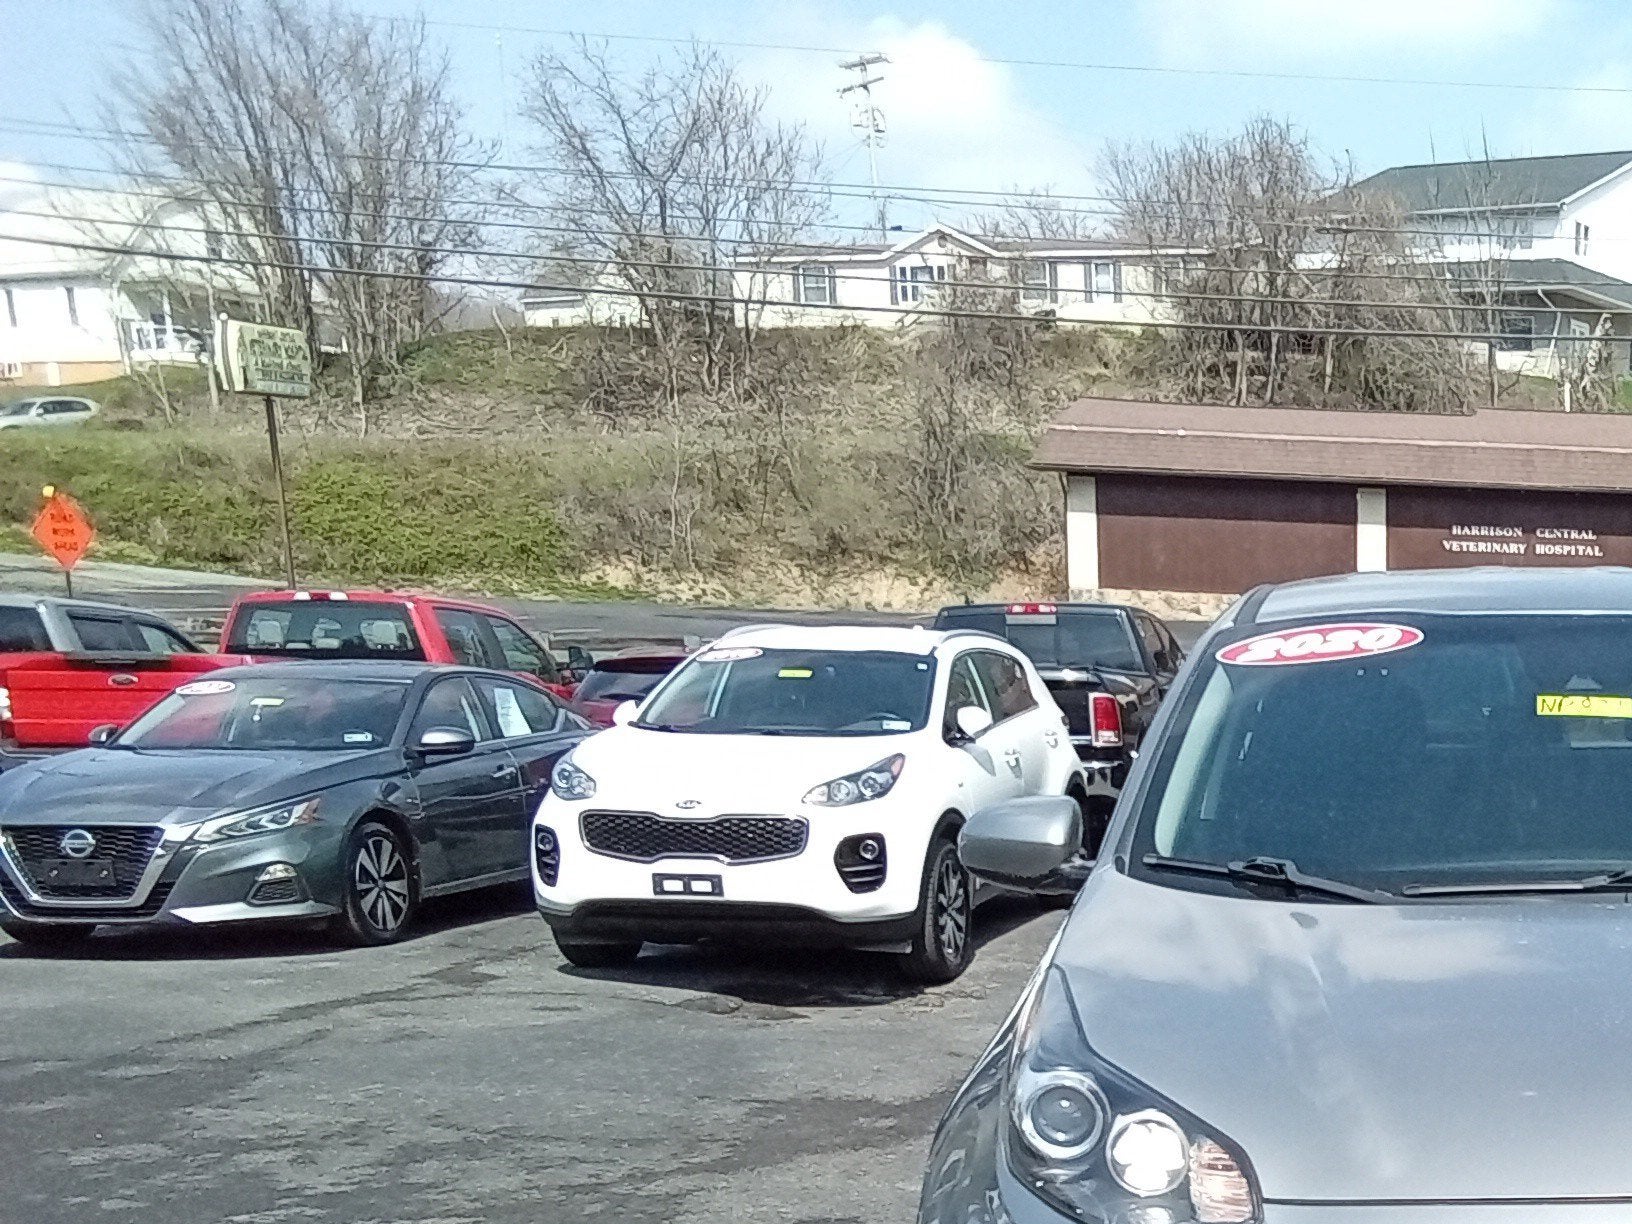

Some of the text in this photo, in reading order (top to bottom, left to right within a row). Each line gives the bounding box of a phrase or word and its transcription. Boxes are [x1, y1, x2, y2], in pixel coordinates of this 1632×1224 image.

[1452, 524, 1597, 540] HARRISON CENTRAL
[1442, 540, 1604, 557] VETERINARY HOSPITAL
[1235, 627, 1404, 662] 2020
